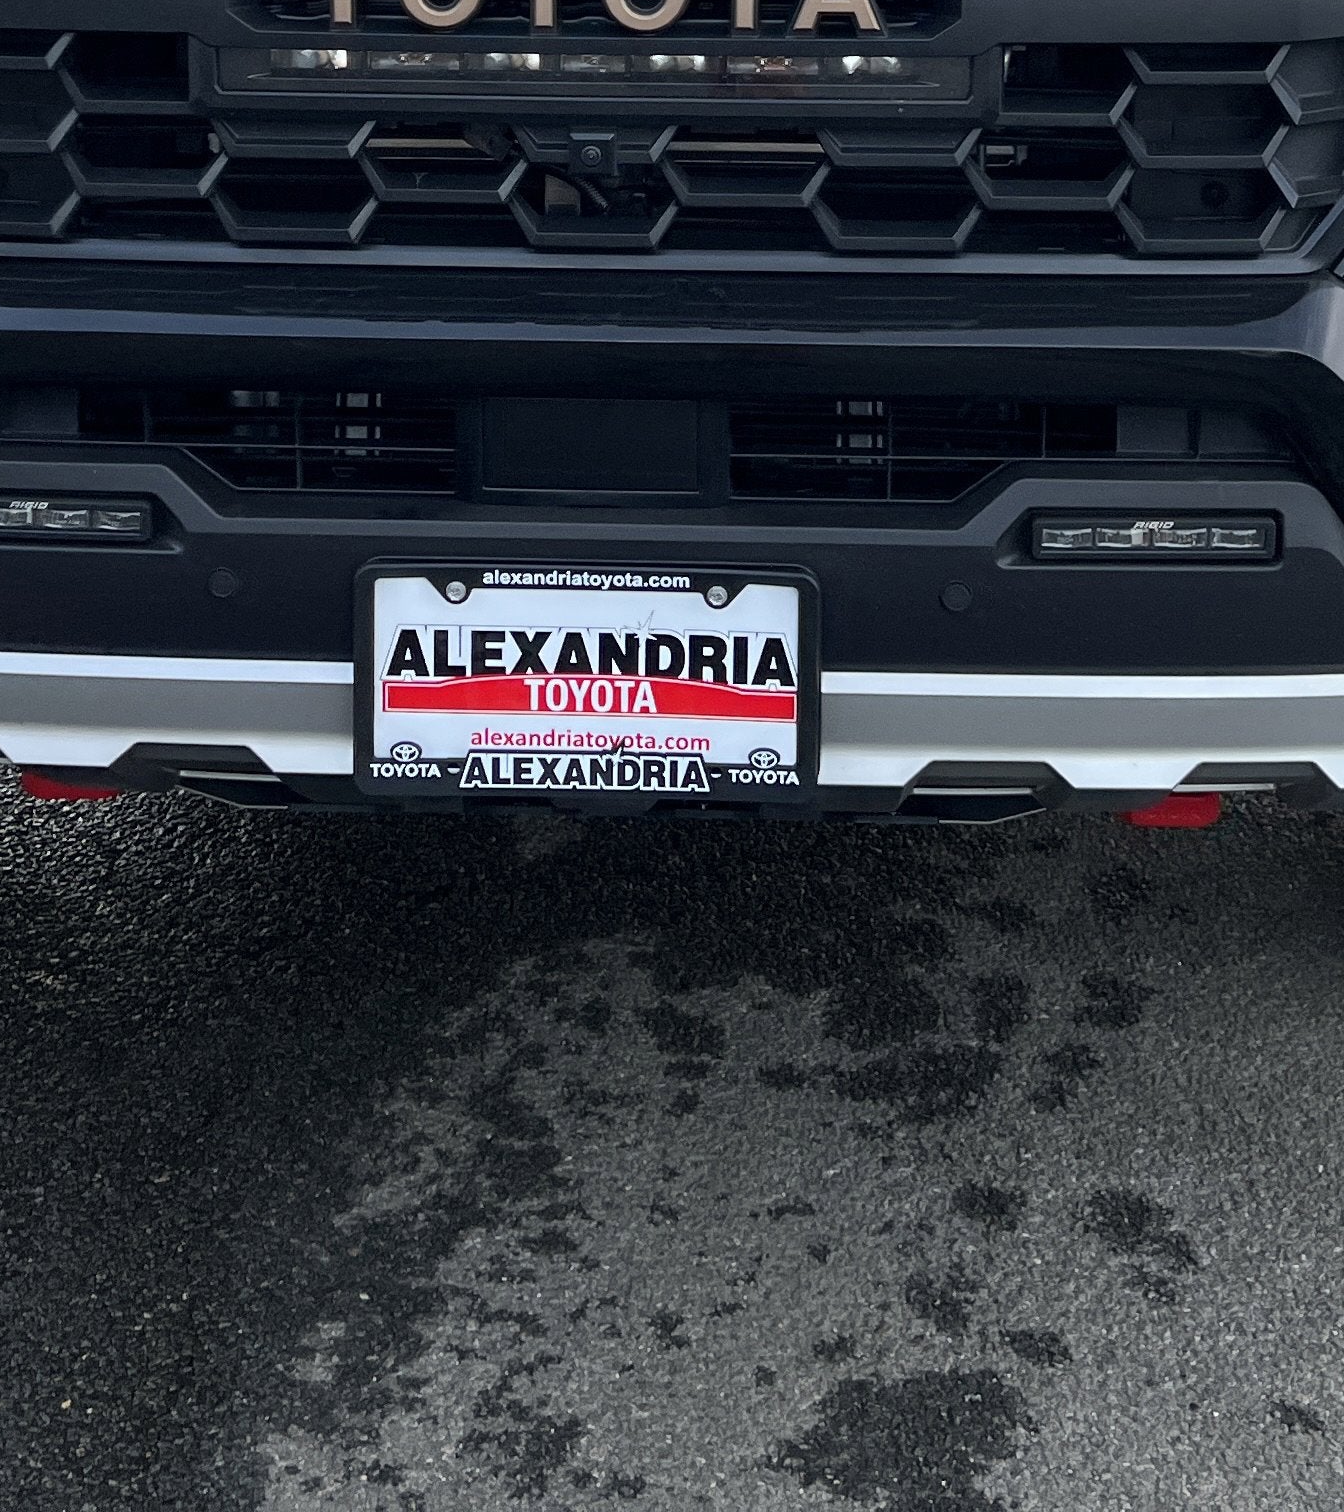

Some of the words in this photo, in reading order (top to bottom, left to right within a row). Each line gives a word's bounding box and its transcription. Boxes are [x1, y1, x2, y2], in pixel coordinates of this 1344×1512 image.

[1133, 521, 1175, 530] RIGID
[482, 569, 691, 590] alexandriatoyota.com
[385, 627, 797, 688] ALEXANDRIA
[523, 677, 658, 714] TOYOTA
[471, 727, 711, 752] alexandriatoyota.com
[369, 762, 441, 779] TOYOTA
[460, 752, 710, 792] ALEXANDRIA
[728, 767, 800, 786] TOYOTA
